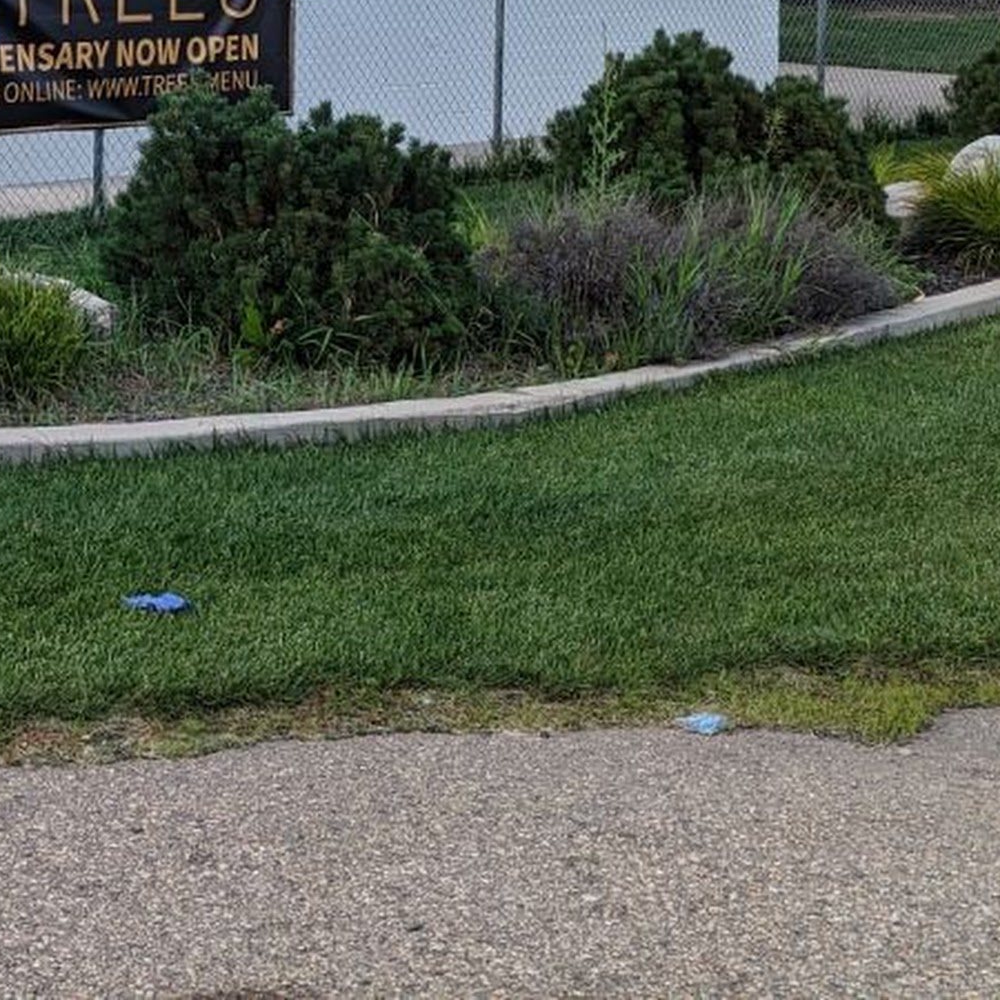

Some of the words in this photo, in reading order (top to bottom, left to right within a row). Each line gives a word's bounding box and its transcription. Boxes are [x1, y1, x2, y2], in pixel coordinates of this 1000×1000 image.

[117, 39, 182, 67] NOW
[186, 34, 259, 63] OPEN
[4, 78, 82, 104] ONLINE:
